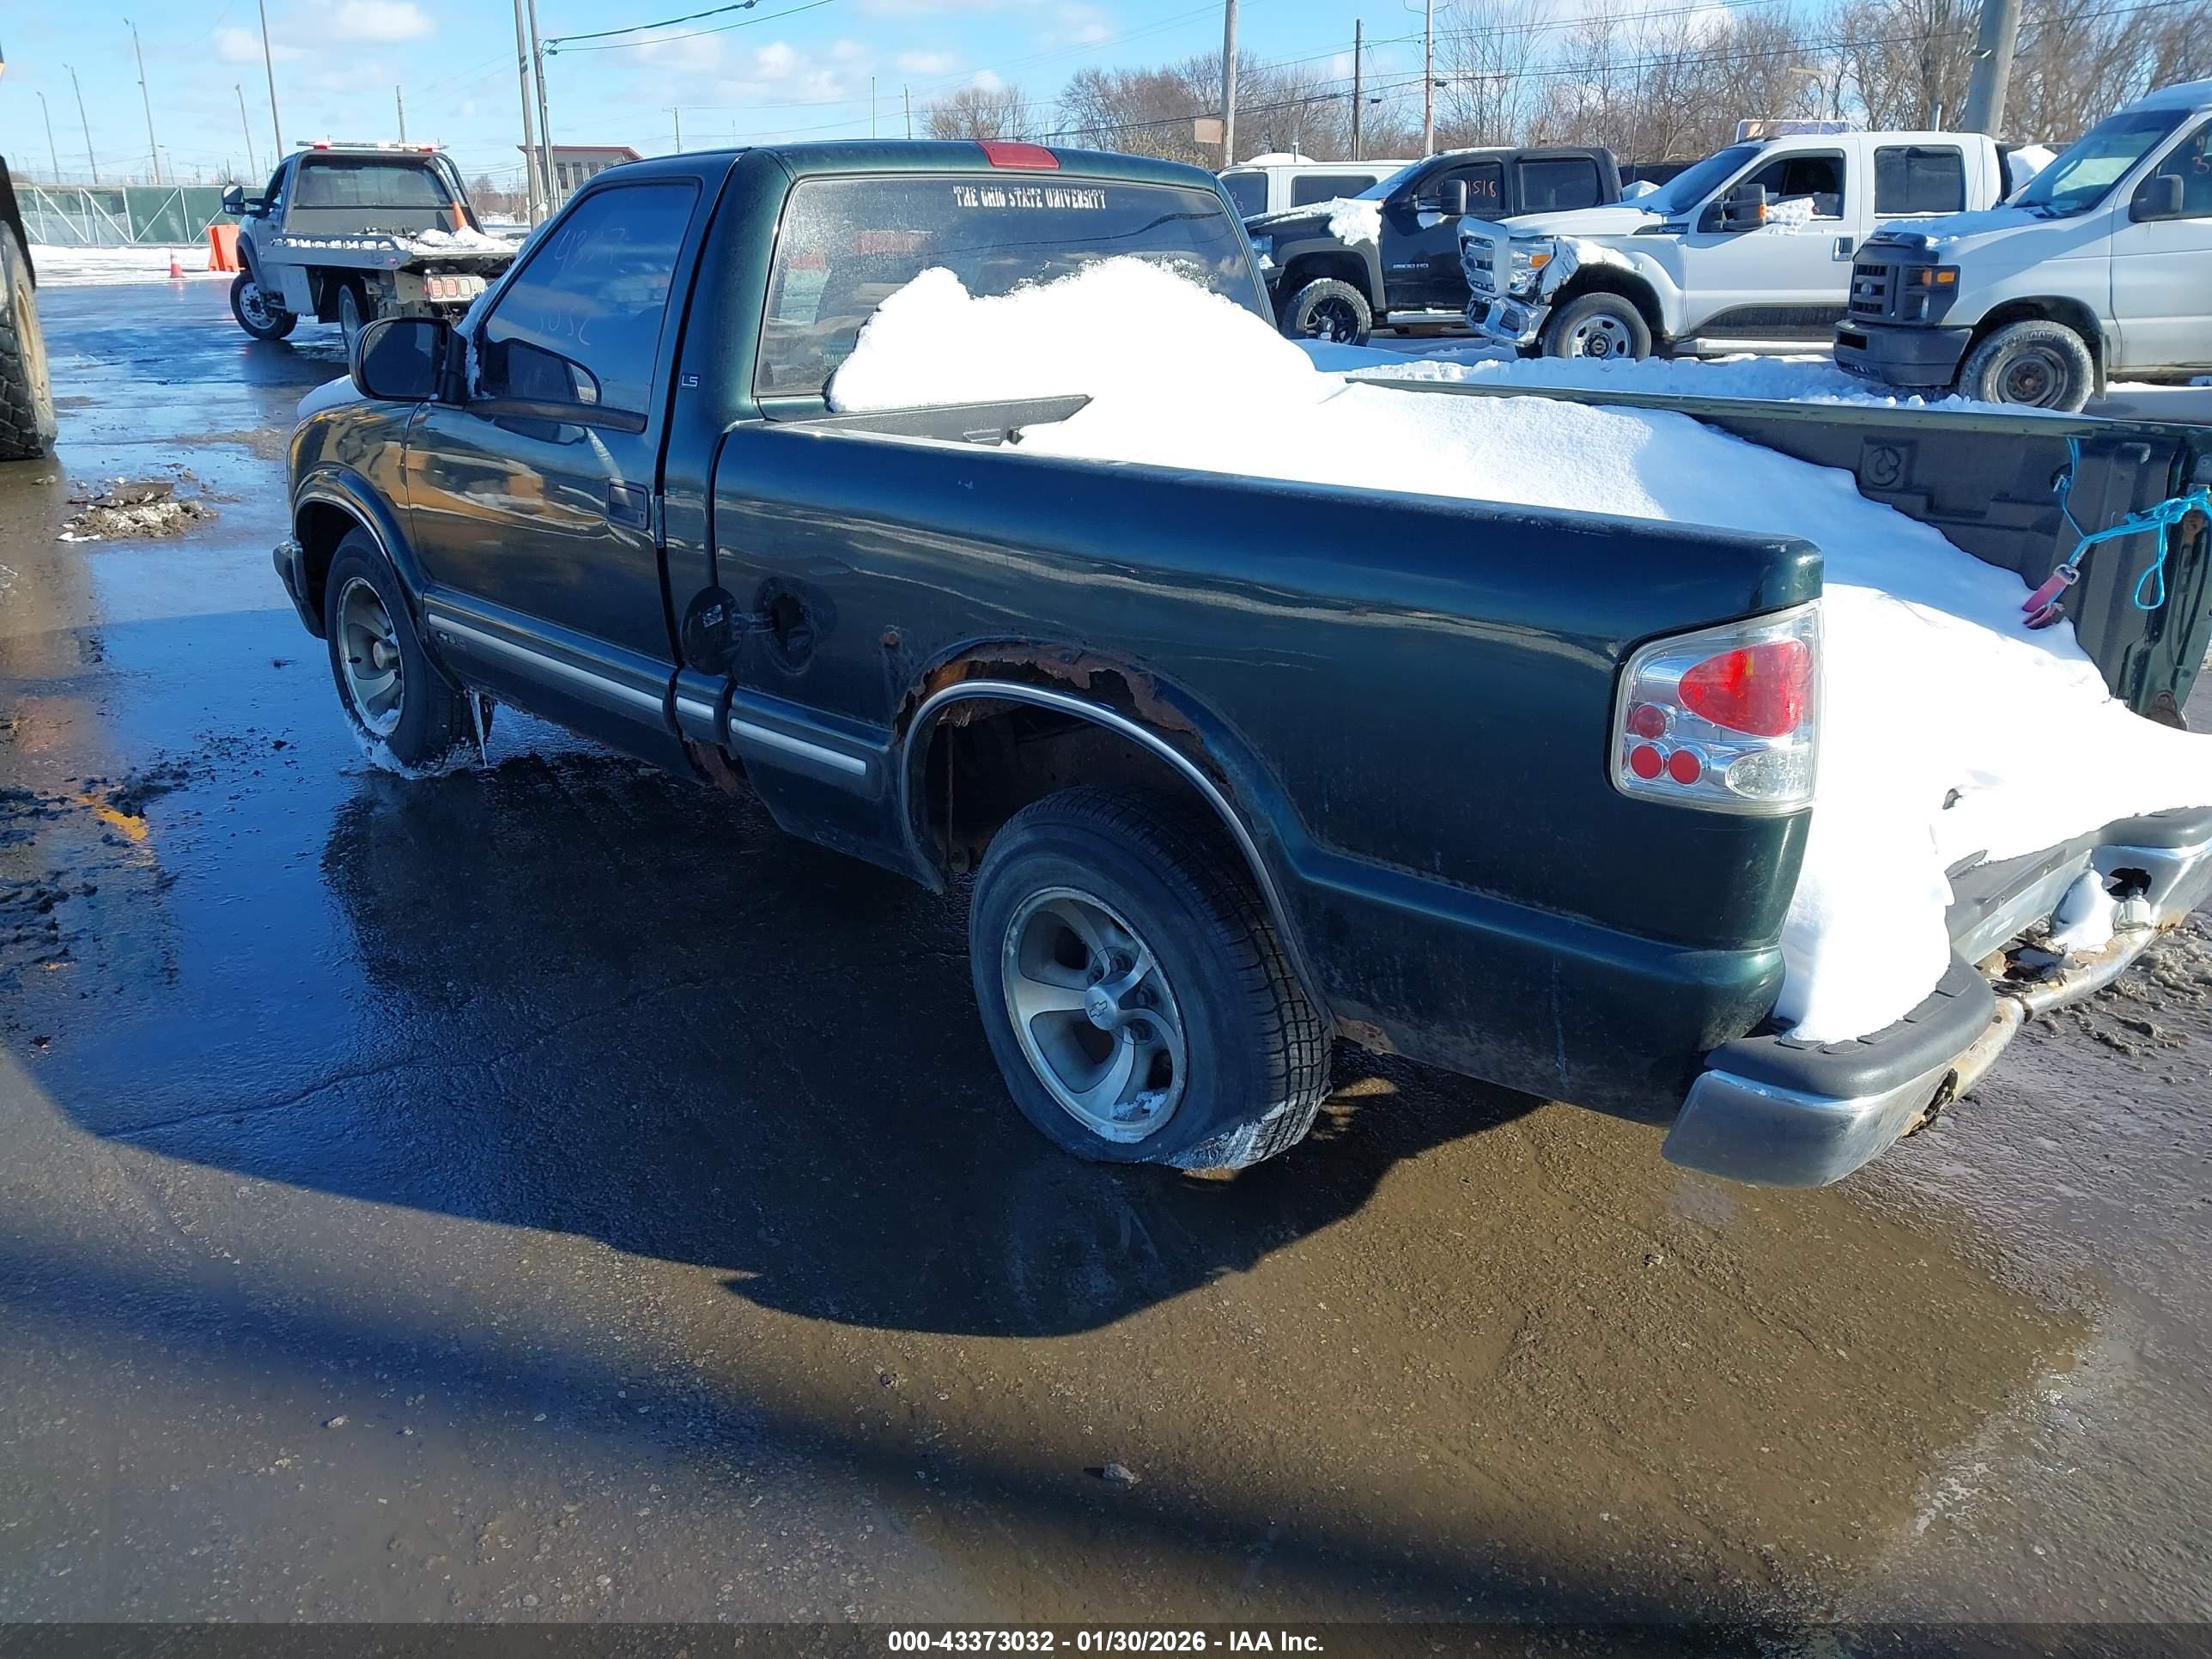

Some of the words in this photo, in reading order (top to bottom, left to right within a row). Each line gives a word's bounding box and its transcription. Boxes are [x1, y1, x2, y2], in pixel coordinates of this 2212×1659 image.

[953, 185, 978, 207] THE
[981, 185, 1006, 207] OHIO
[1009, 186, 1042, 208] STATE
[1045, 187, 1105, 209] UNIVERSITY
[681, 374, 699, 387] LS
